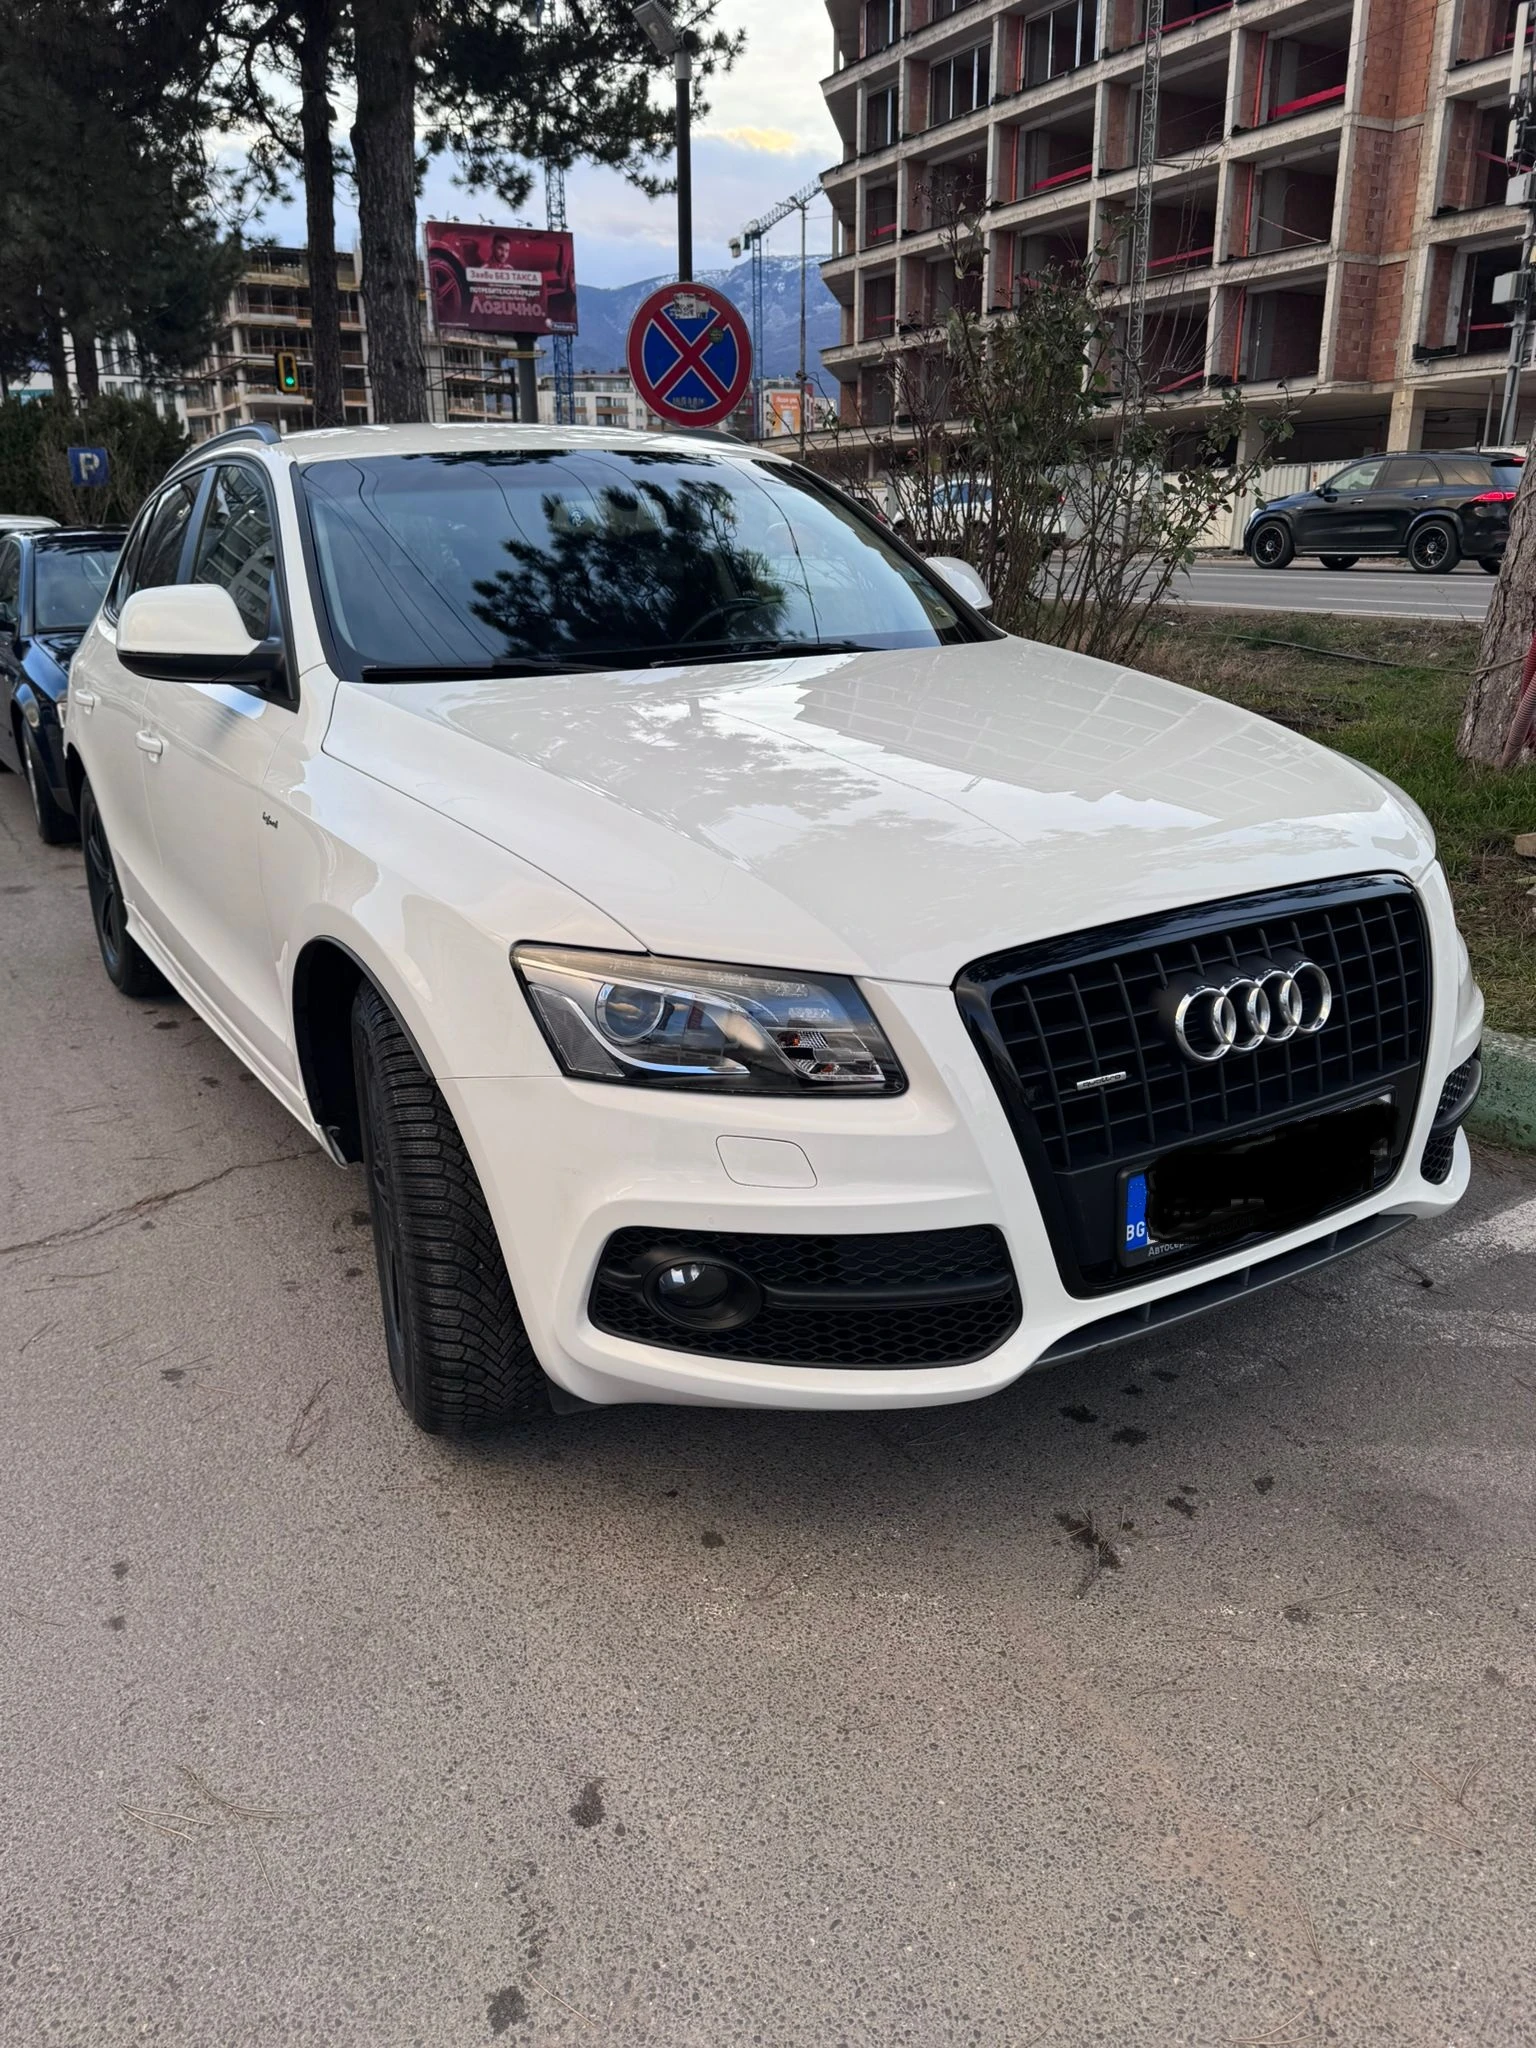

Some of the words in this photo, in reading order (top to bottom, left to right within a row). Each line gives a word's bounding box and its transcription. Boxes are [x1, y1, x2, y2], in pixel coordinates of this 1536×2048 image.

[494, 272, 510, 281] БЕЗ
[512, 272, 539, 282] ТАКСА
[79, 452, 100, 480] P
[1126, 1221, 1146, 1242] BG
